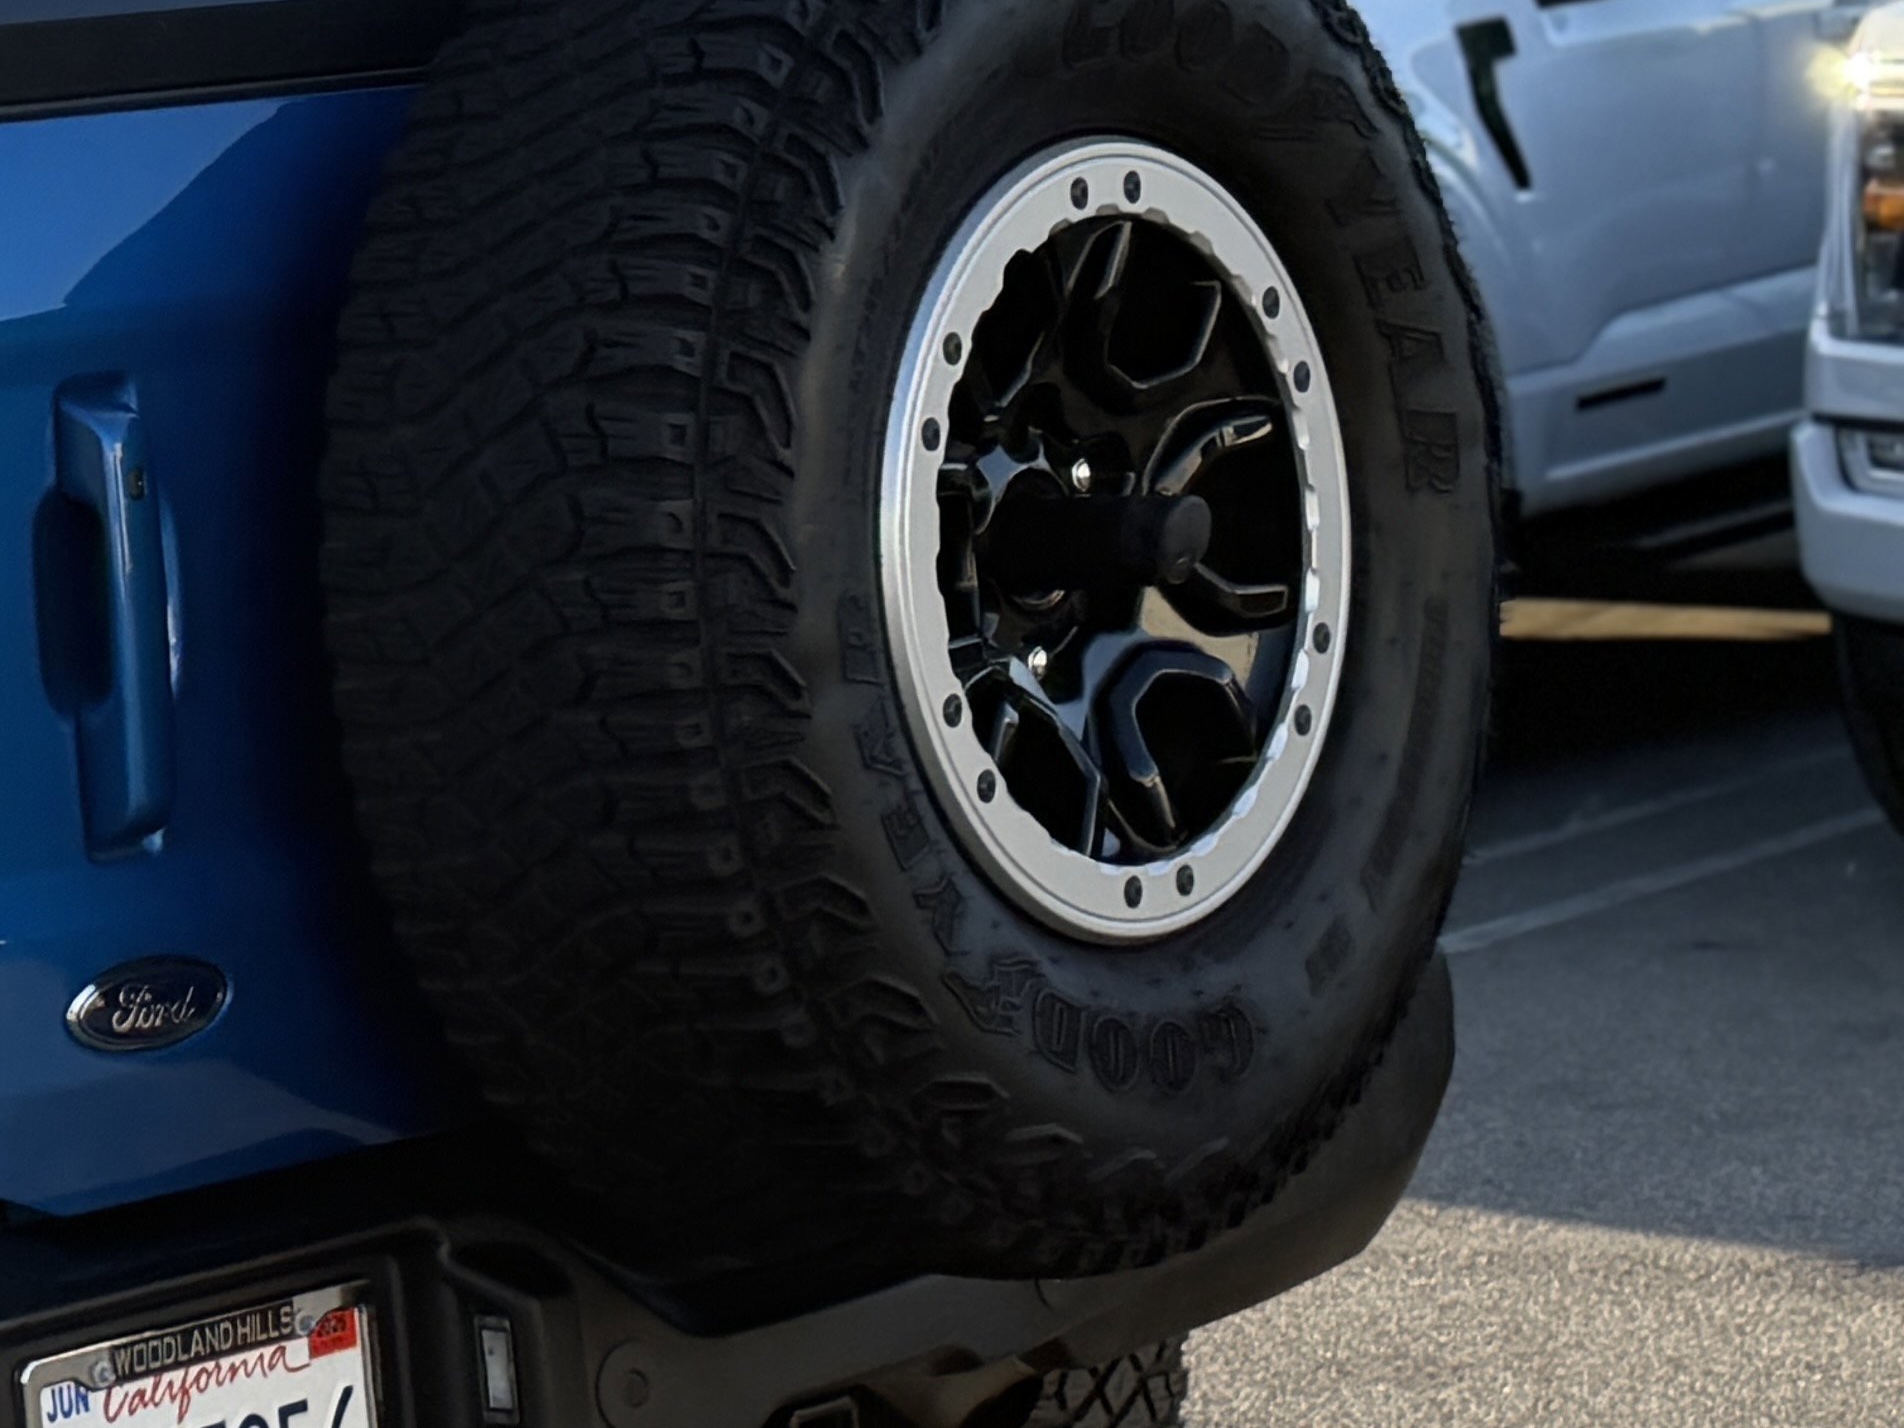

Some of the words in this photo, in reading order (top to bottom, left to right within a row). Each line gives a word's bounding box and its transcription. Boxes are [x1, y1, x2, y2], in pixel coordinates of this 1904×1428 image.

[111, 985, 196, 1034] Ford
[114, 1320, 233, 1376] WOODLAND
[237, 1306, 294, 1345] HILLS
[46, 1384, 90, 1424] JUN
[103, 1343, 310, 1425] California
